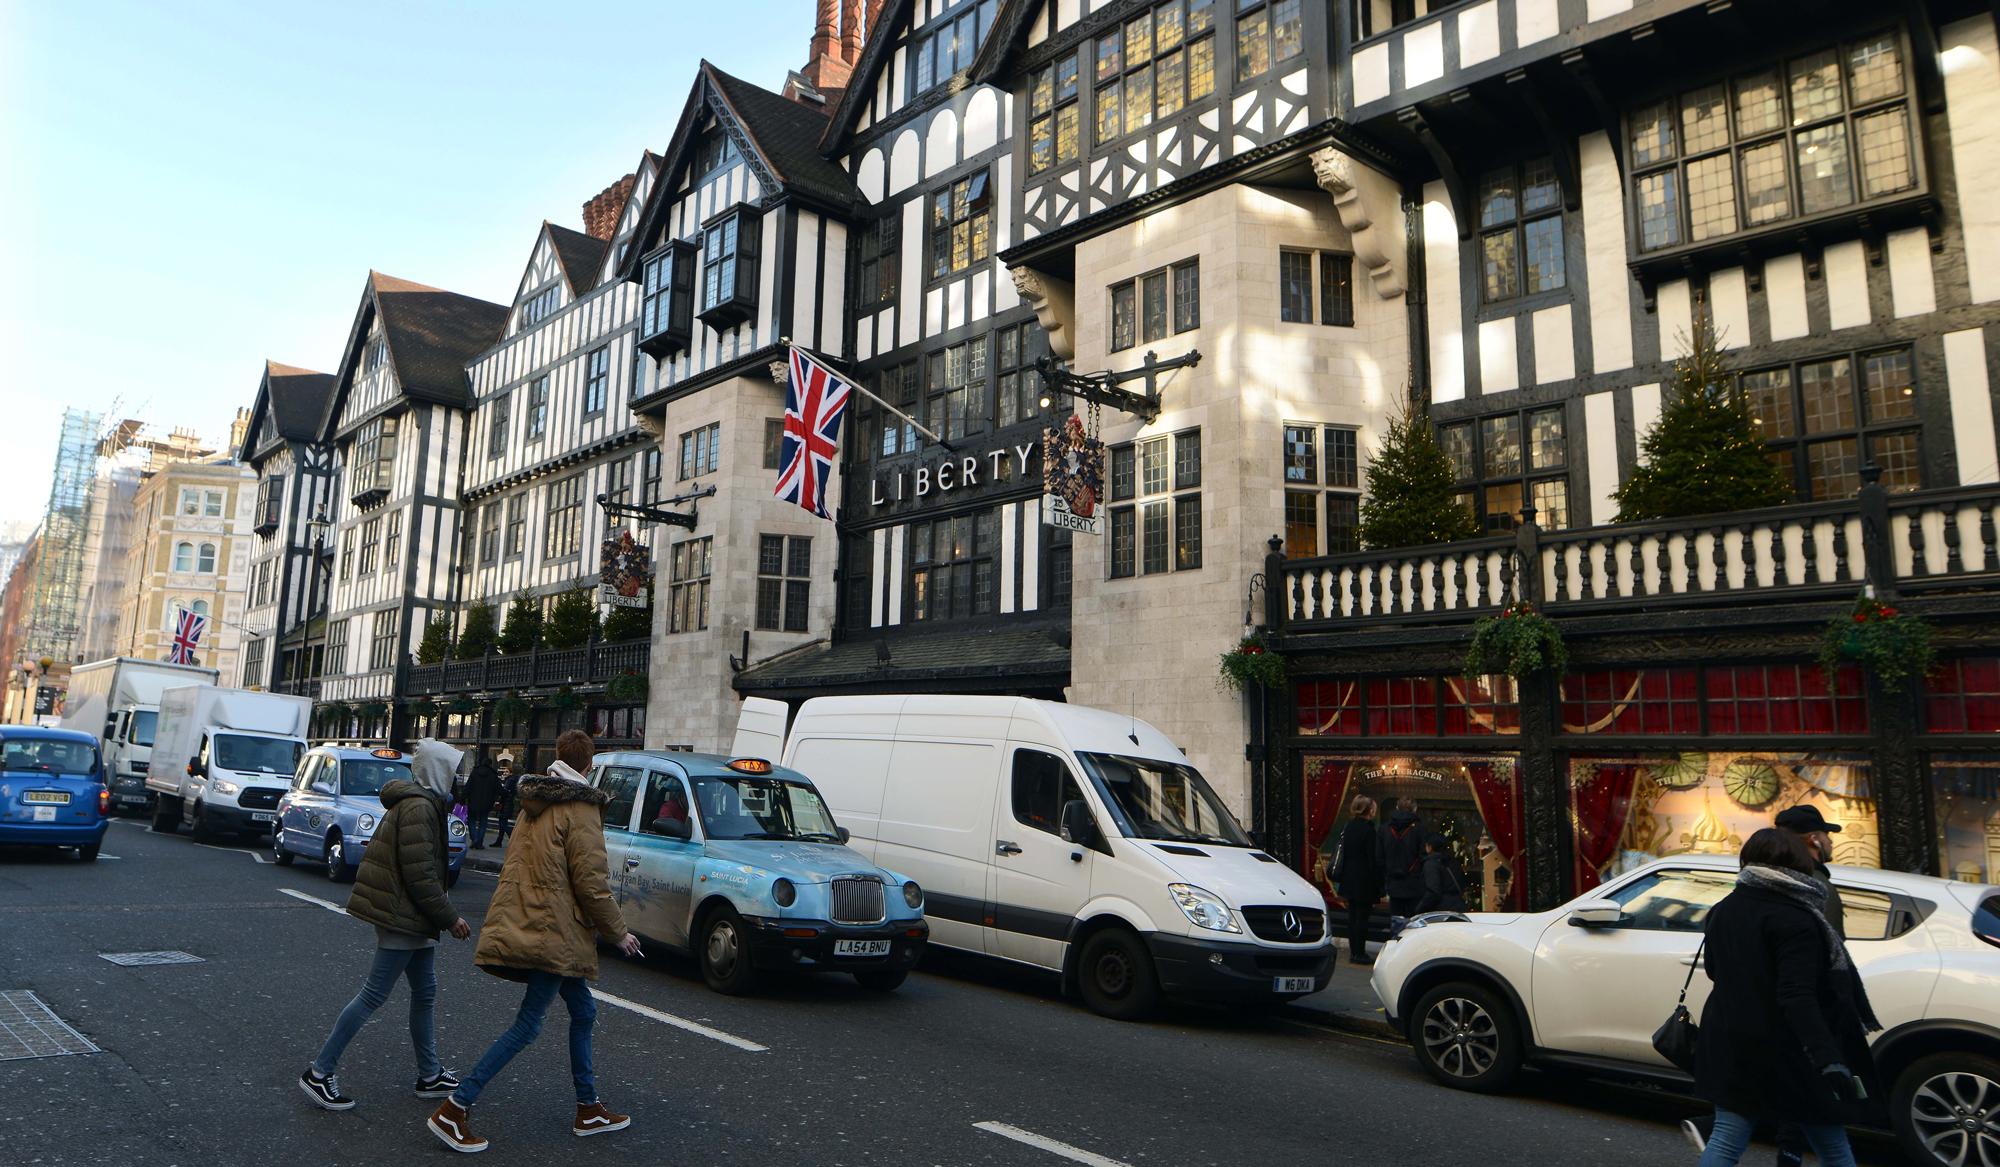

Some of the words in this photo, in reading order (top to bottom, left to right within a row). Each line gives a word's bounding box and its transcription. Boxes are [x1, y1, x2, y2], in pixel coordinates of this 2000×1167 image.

[871, 442, 1034, 506] LIBERTY
[1364, 769, 1383, 780] THE
[612, 868, 637, 887] Morgan
[652, 878, 670, 892] Saint
[671, 882, 692, 896] Lucia
[711, 871, 729, 882] SAINT
[729, 874, 749, 885] LUCIA
[839, 940, 867, 953] LA54
[868, 941, 888, 953] BNU
